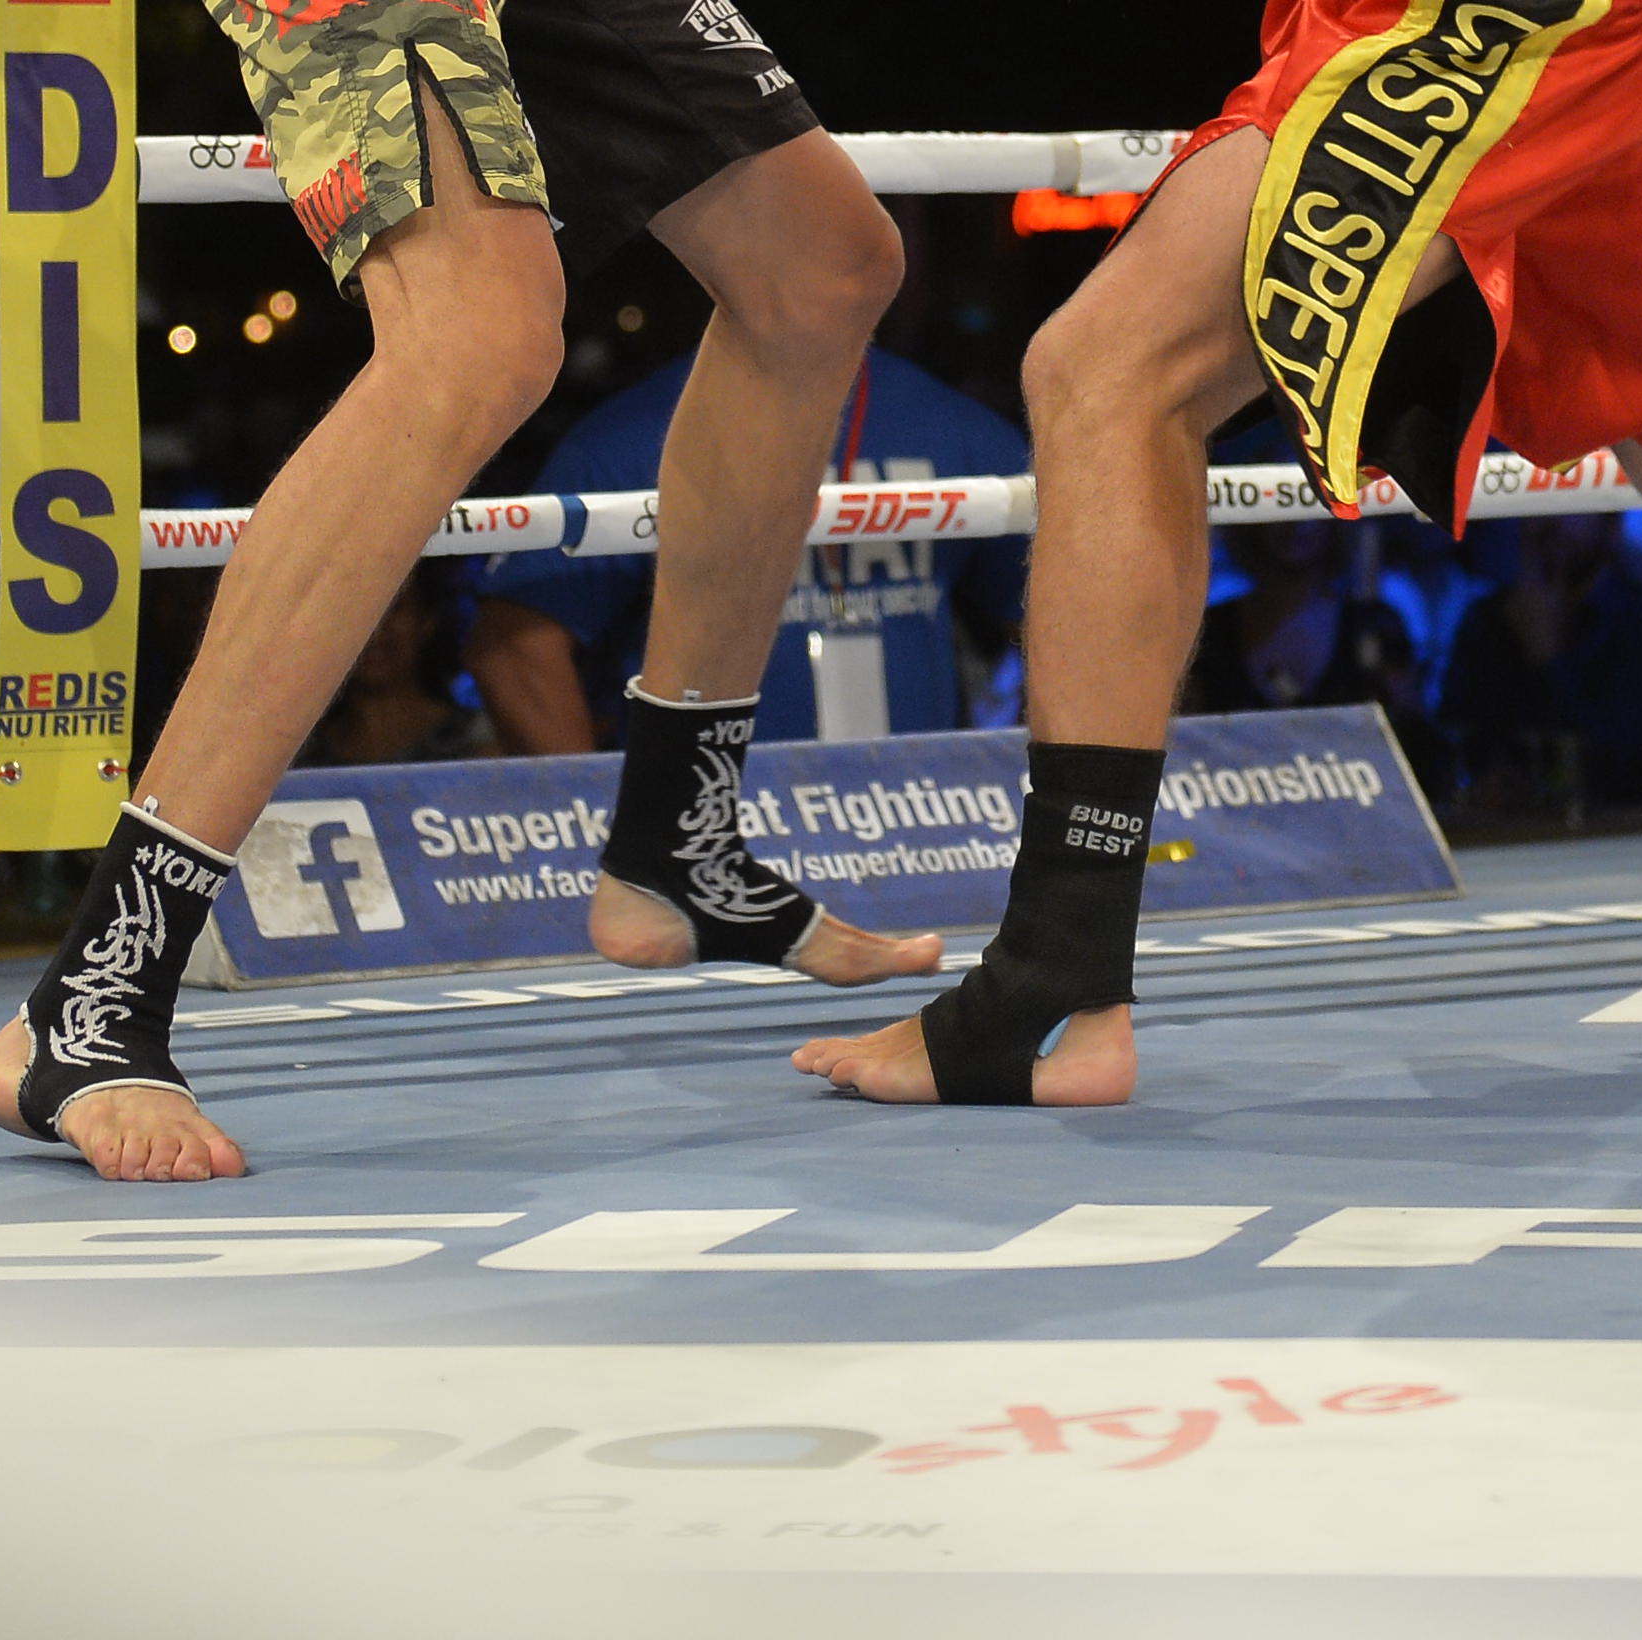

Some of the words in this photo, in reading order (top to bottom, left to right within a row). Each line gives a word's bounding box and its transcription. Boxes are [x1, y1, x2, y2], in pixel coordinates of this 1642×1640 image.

[829, 490, 967, 535] SOFT
[0, 670, 128, 710] REDIS
[790, 773, 1019, 842] Fighting
[1069, 804, 1144, 835] BUDO
[1065, 826, 1135, 858] BEST
